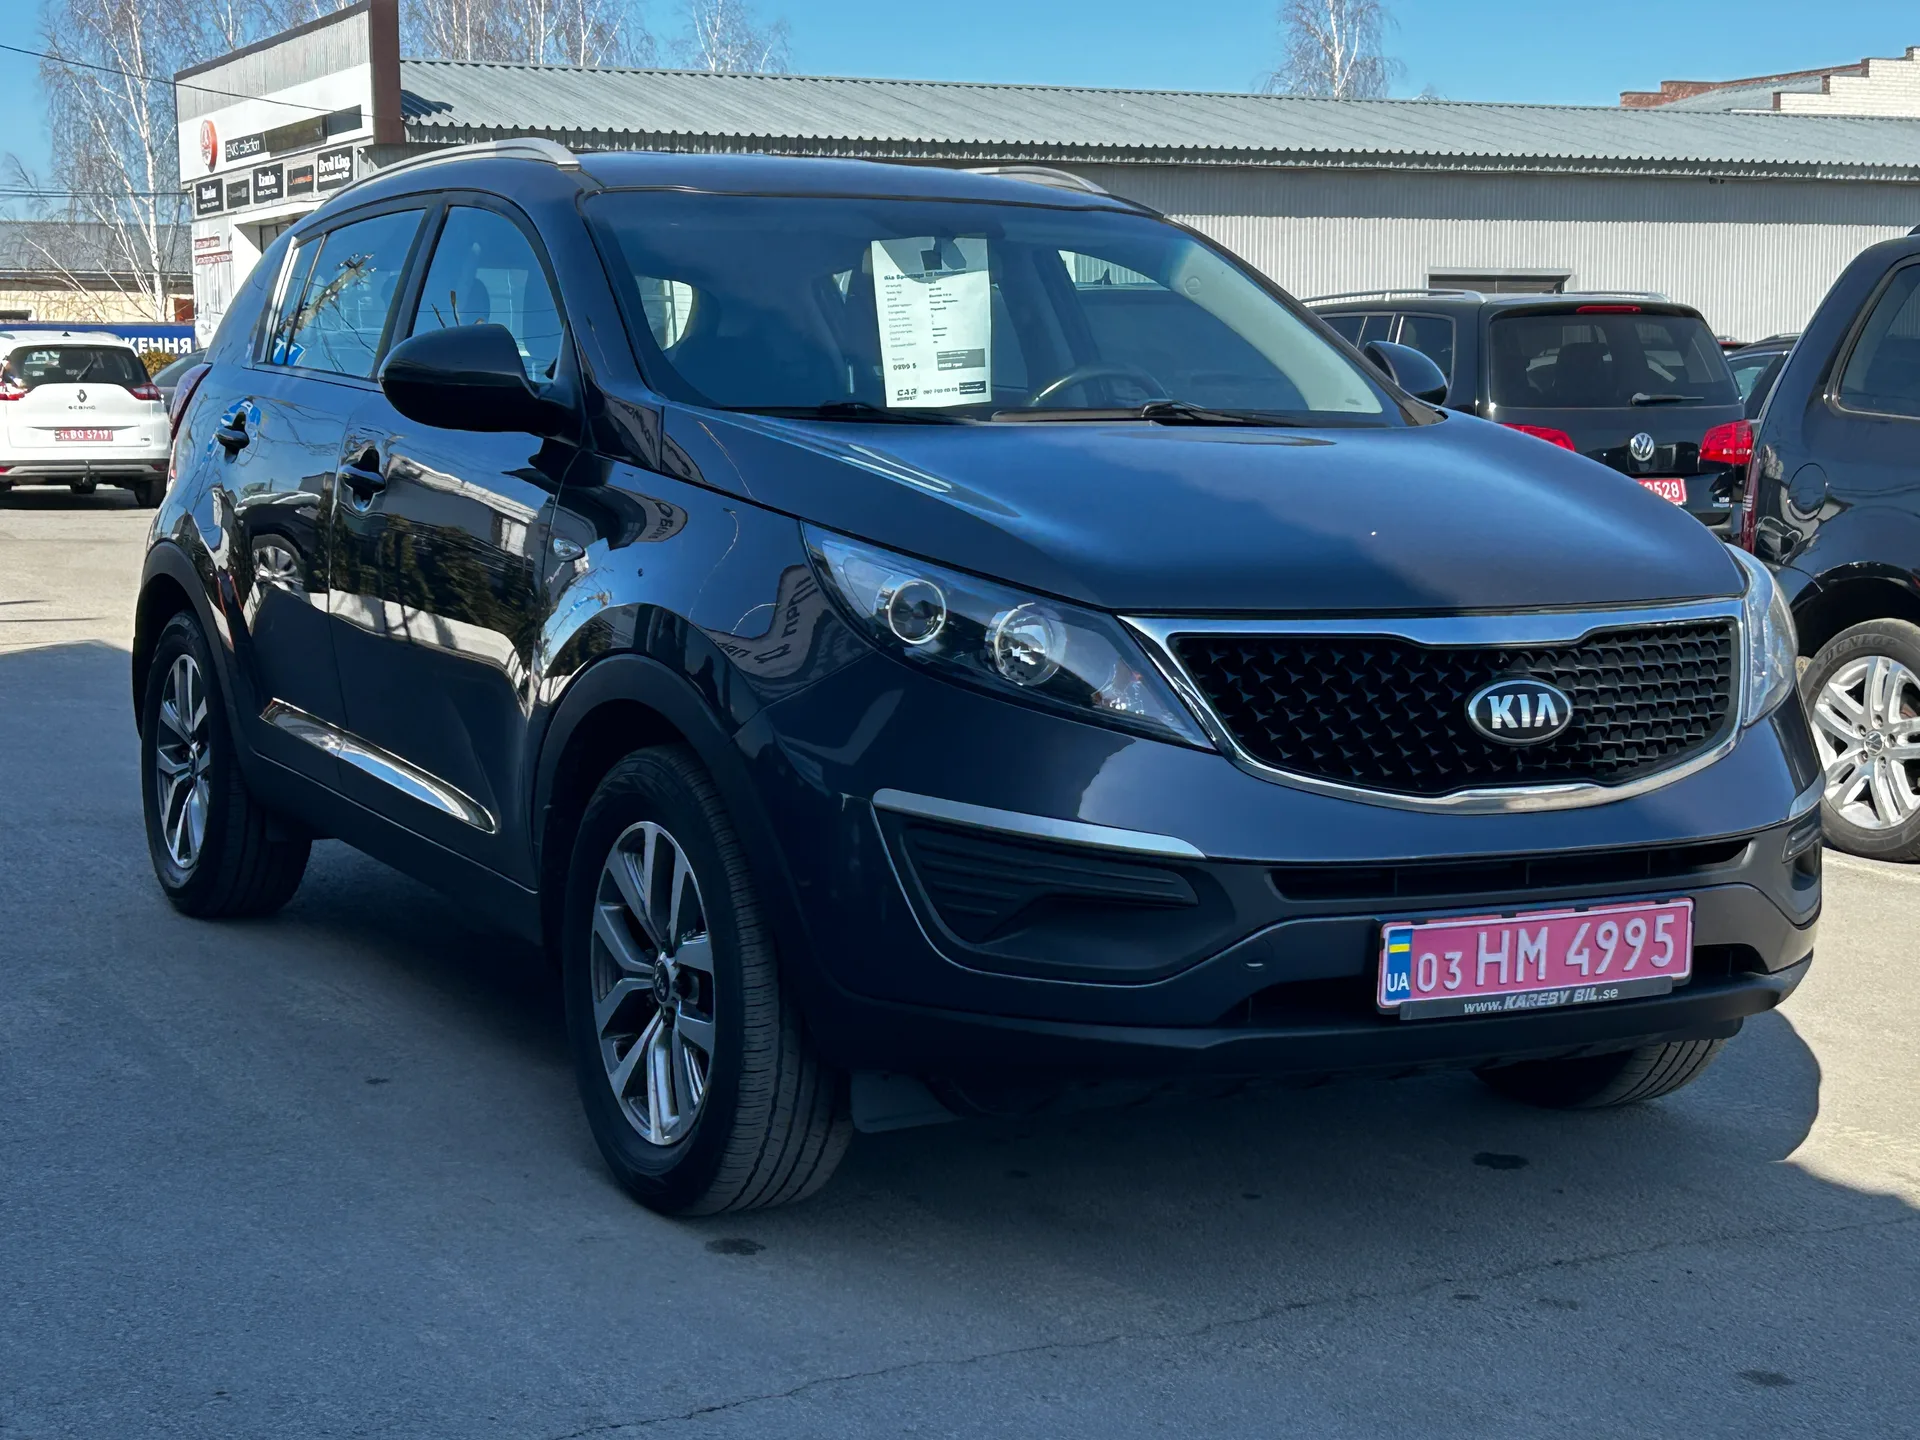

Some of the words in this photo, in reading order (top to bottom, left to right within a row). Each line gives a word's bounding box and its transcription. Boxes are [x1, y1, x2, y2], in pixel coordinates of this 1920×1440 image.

[1825, 632, 1898, 661] DUNLOP
[1487, 693, 1559, 729] KIA
[1416, 951, 1464, 993] 03
[1475, 926, 1549, 986] HM
[1565, 914, 1675, 977] 4995
[1387, 972, 1410, 993] UA
